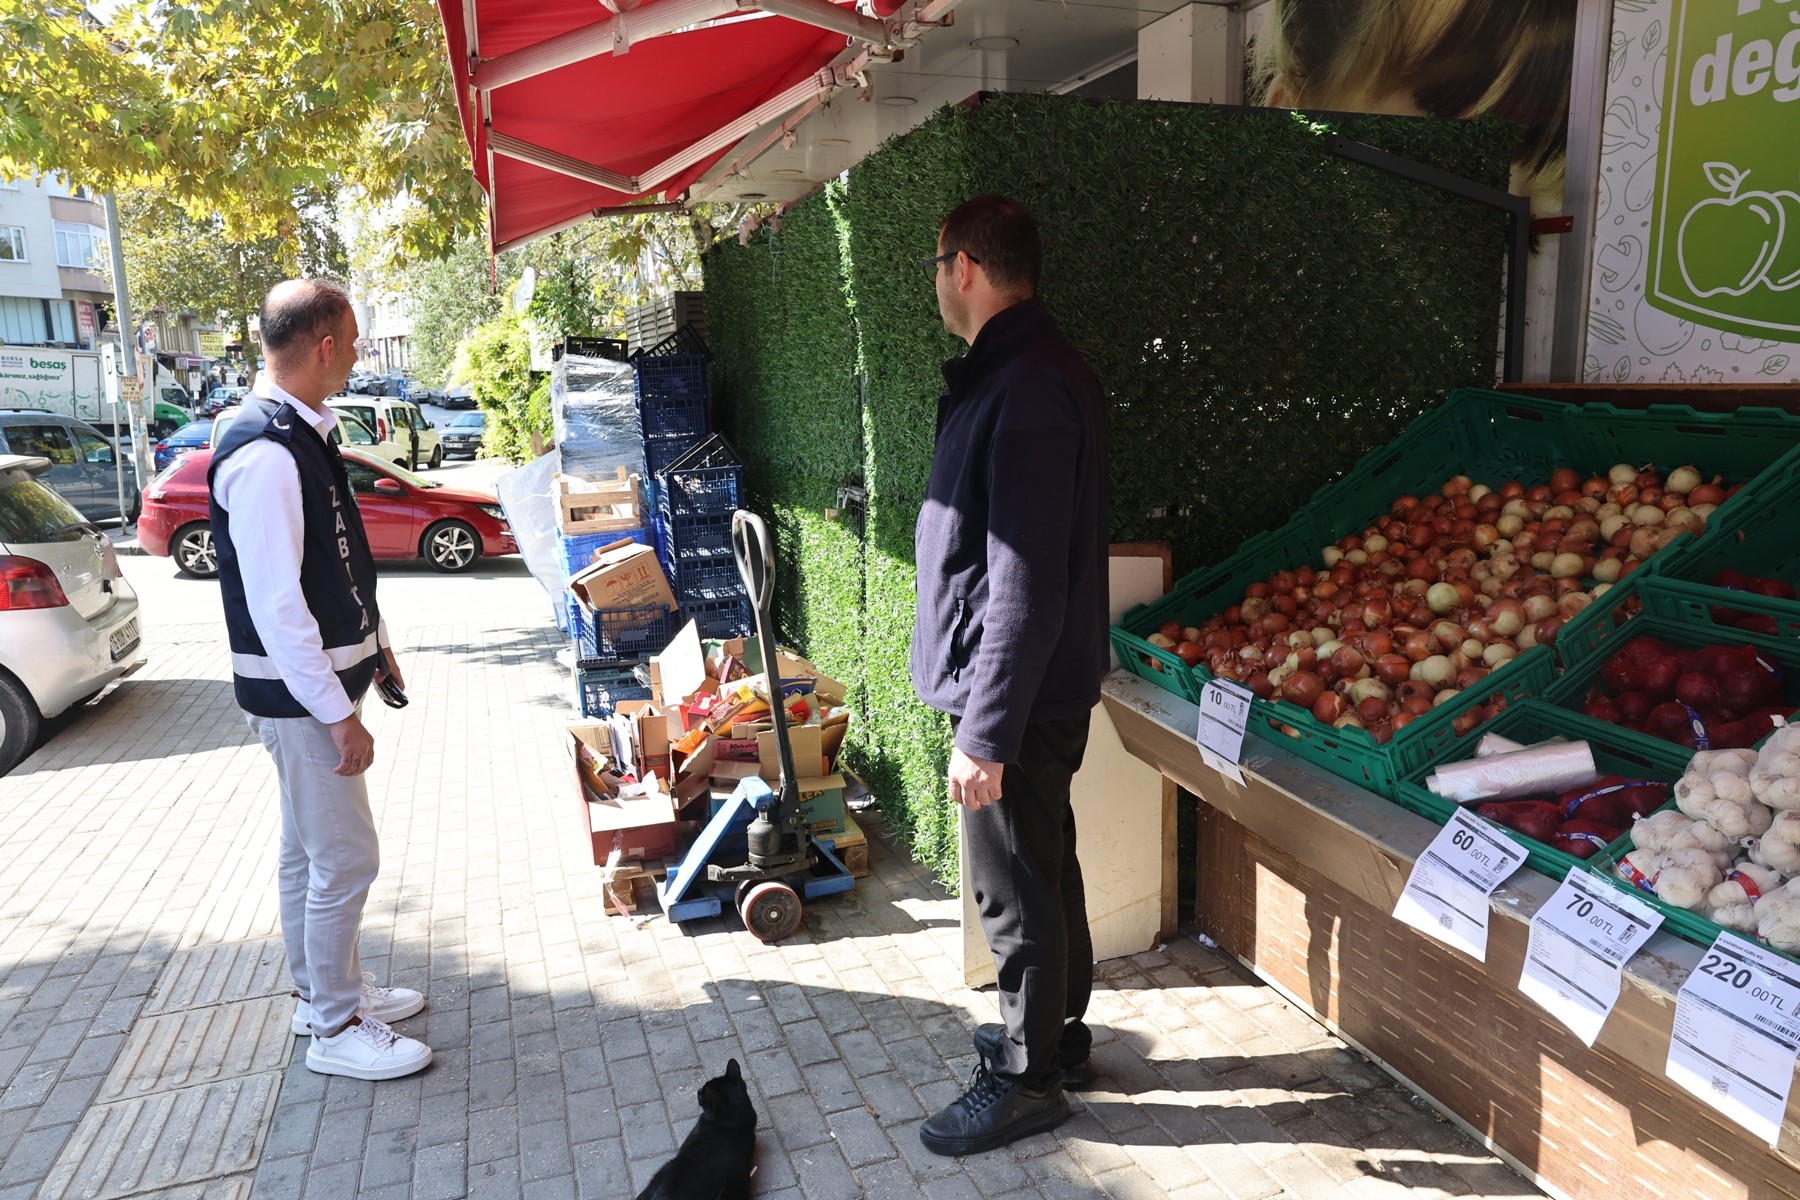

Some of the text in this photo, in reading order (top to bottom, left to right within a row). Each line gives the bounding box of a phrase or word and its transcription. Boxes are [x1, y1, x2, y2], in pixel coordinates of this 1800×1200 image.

[30, 357, 67, 371] besaş
[328, 485, 370, 631] ZABITA
[710, 702, 732, 722] Albeni
